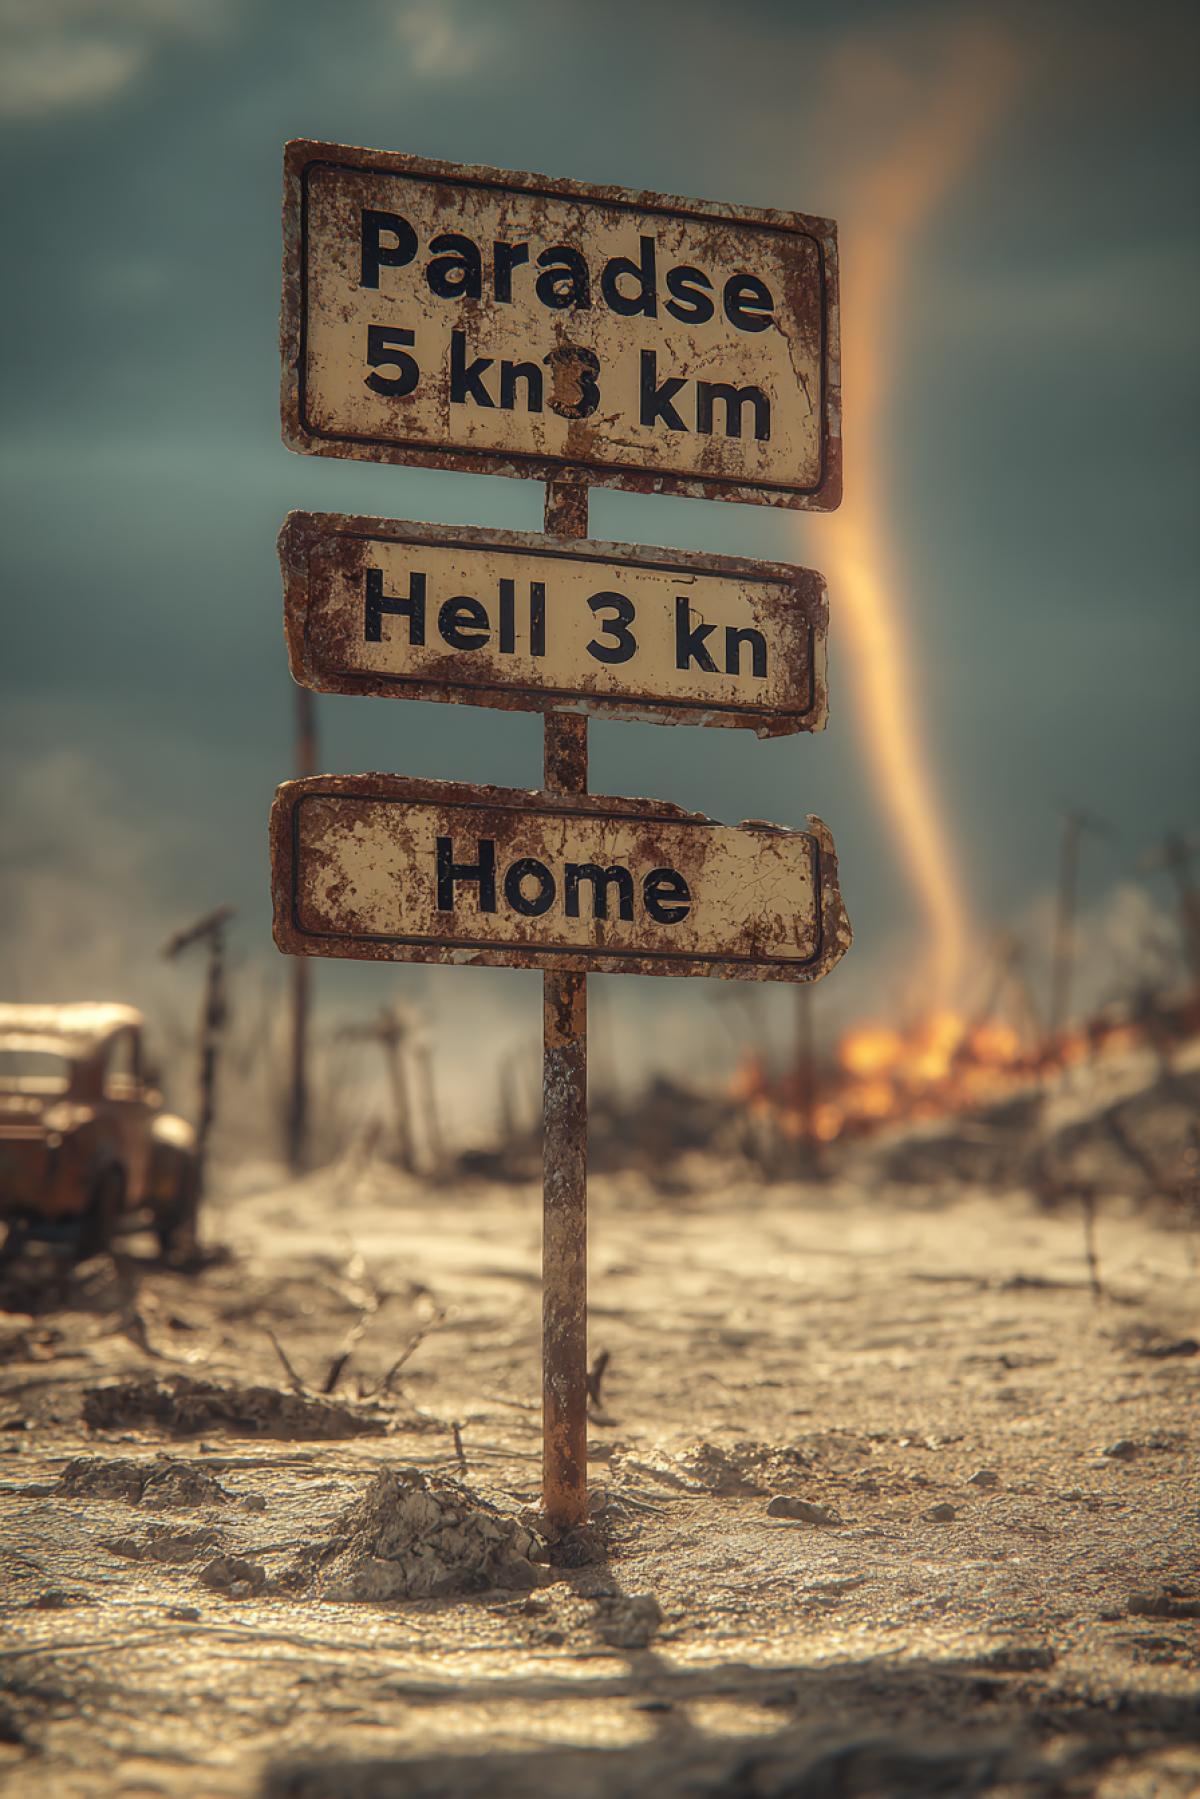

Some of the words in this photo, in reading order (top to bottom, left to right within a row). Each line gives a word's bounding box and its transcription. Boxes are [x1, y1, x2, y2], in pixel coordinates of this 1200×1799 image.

[360, 208, 775, 333] Paradse
[364, 324, 420, 397] 5
[640, 349, 771, 442] km
[365, 568, 546, 657] Hell
[586, 591, 638, 665] 3
[675, 597, 768, 679] kn
[436, 836, 692, 926] Home
